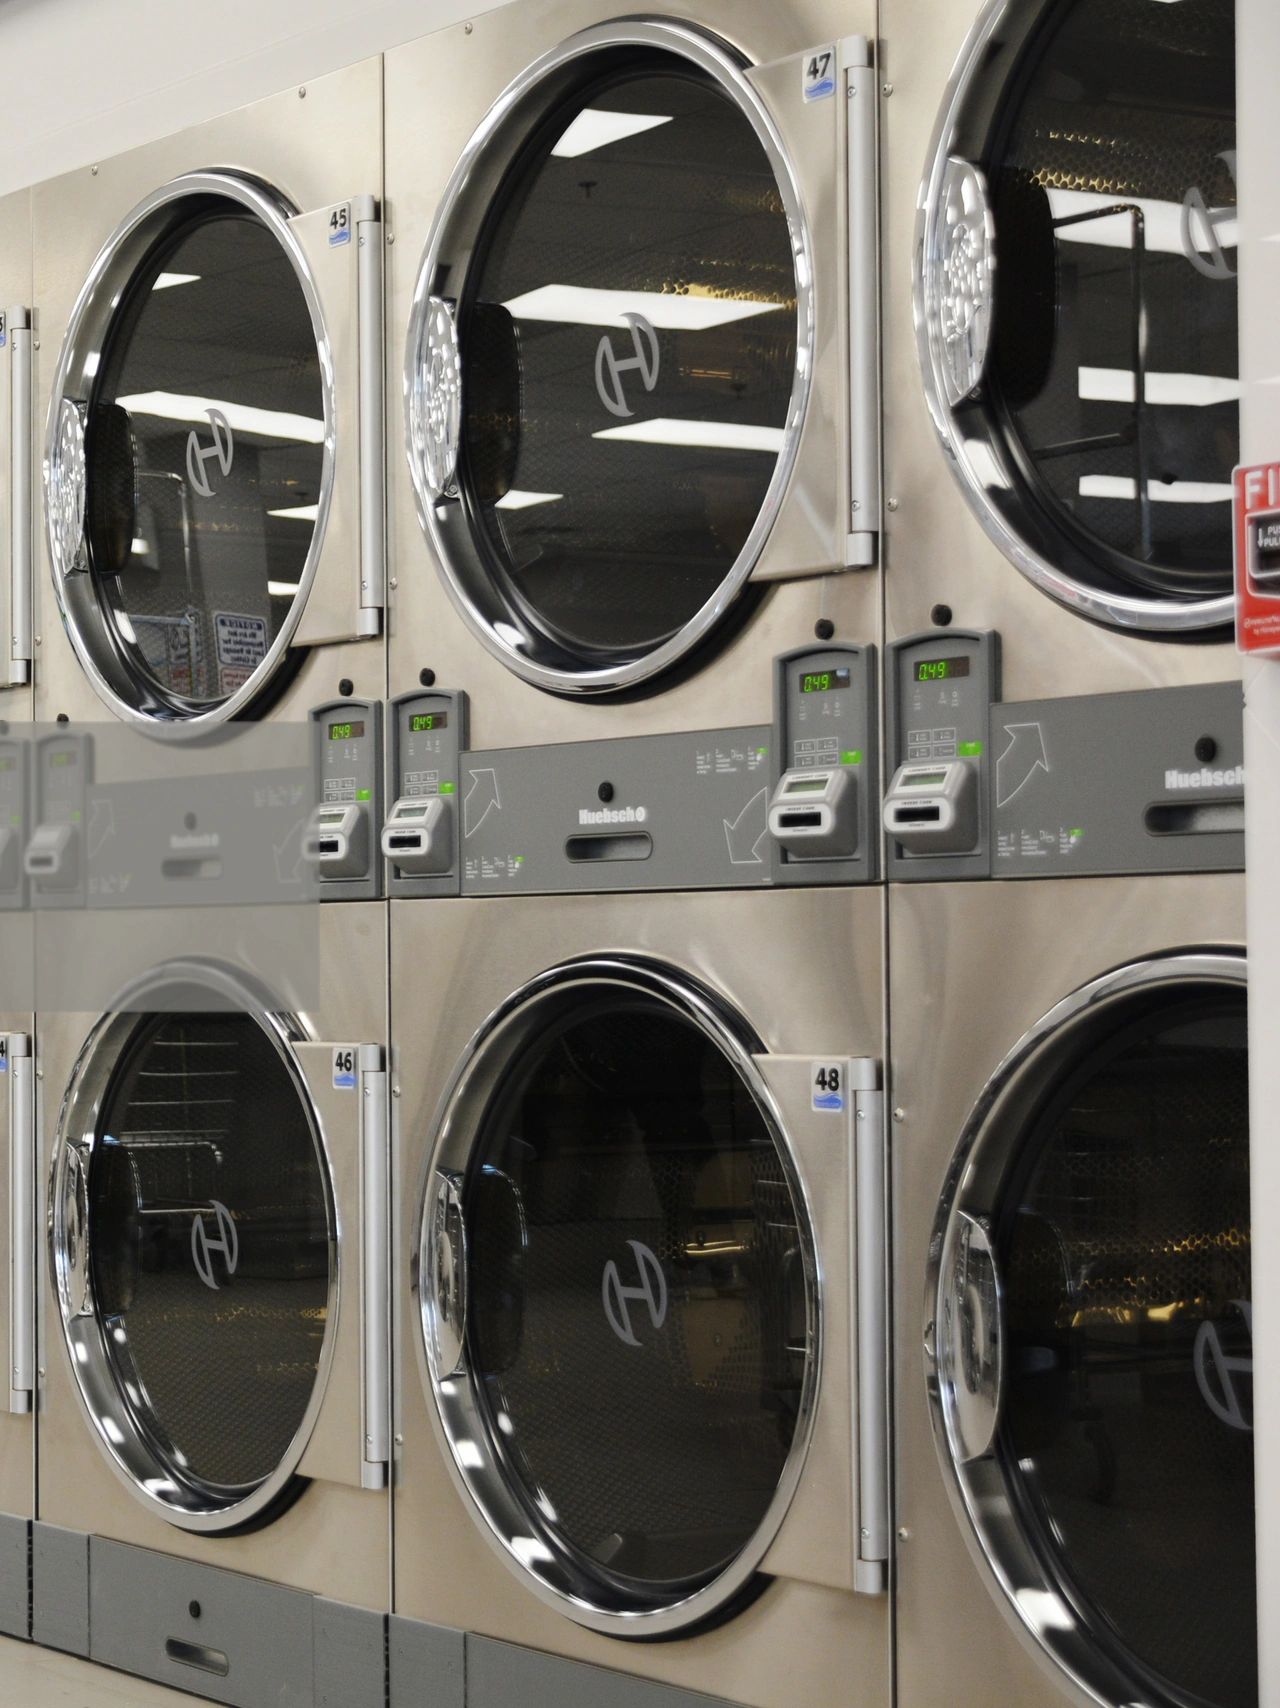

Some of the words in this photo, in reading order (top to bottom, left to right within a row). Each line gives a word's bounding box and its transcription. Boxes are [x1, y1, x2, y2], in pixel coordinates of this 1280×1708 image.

[807, 53, 831, 80] 47
[330, 208, 347, 229] 45
[1245, 467, 1280, 510] FI
[578, 806, 635, 825] Huebsch
[335, 1052, 352, 1072] 46
[815, 1067, 839, 1091] 48
